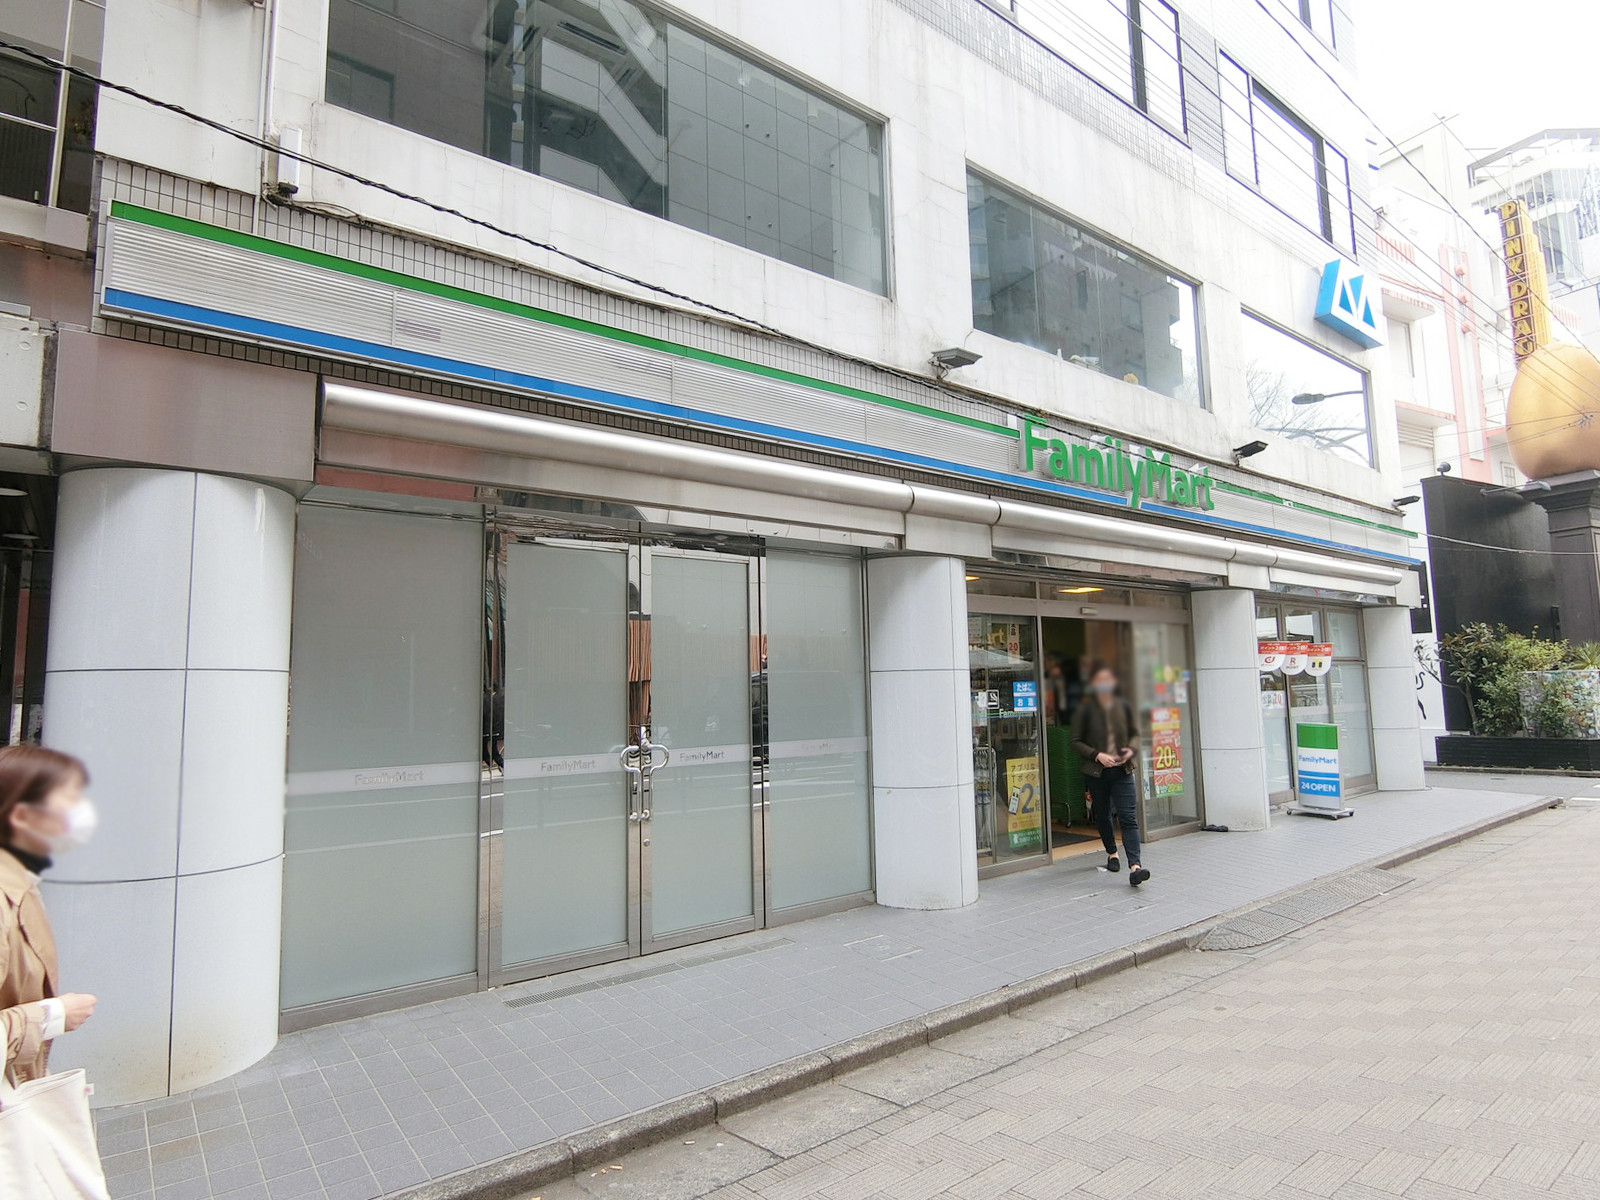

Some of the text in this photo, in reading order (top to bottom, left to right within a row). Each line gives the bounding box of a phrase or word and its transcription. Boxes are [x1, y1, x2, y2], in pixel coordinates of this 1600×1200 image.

[1500, 200, 1523, 276] PINK
[1018, 412, 1215, 511] FamilyMart
[679, 750, 725, 762] FamilyMart
[1298, 754, 1337, 765] FamilyMart
[540, 759, 597, 772] FamilyMart
